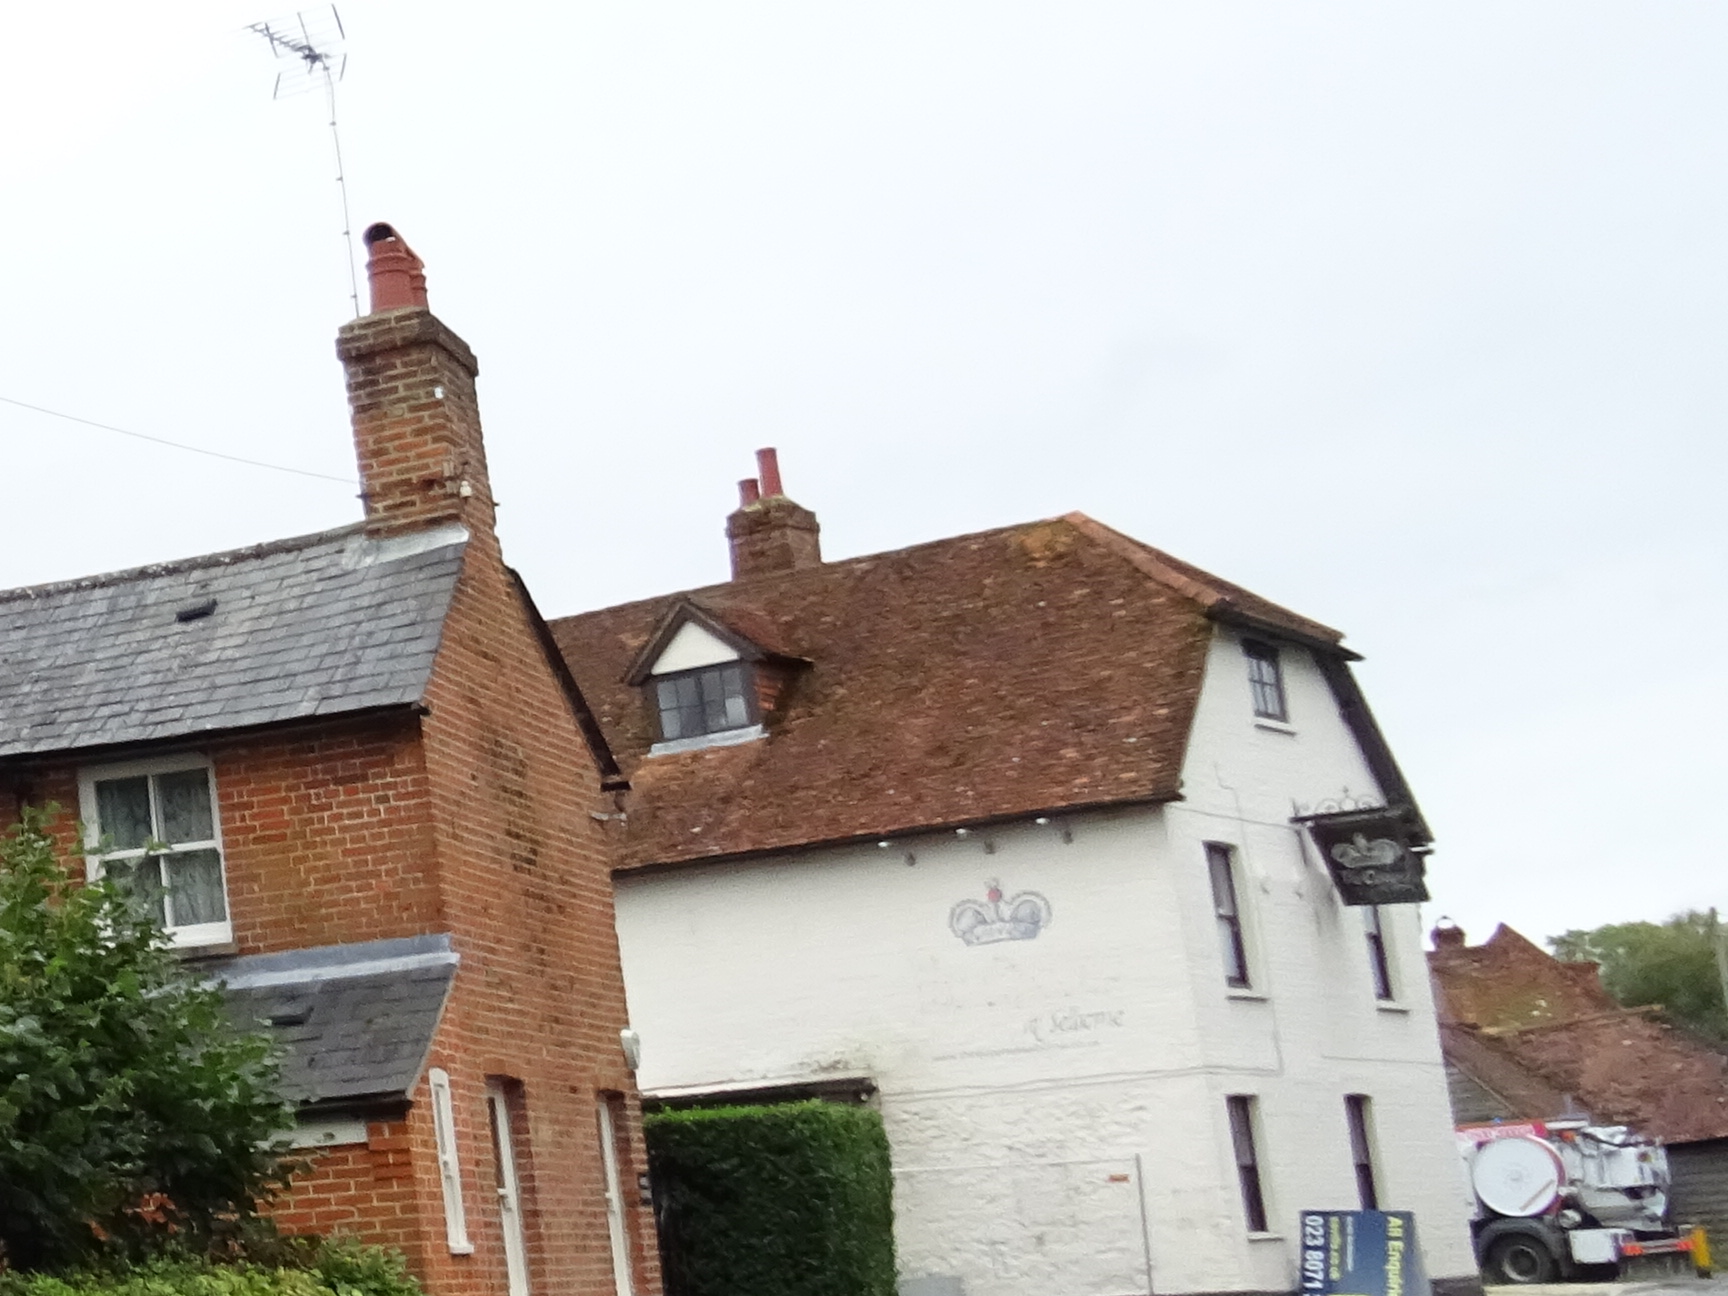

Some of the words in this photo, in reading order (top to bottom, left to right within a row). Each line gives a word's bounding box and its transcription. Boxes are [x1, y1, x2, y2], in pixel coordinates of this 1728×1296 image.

[1304, 1215, 1324, 1247] 023
[1386, 1216, 1403, 1237] All
[1303, 1250, 1324, 1289] 8071
